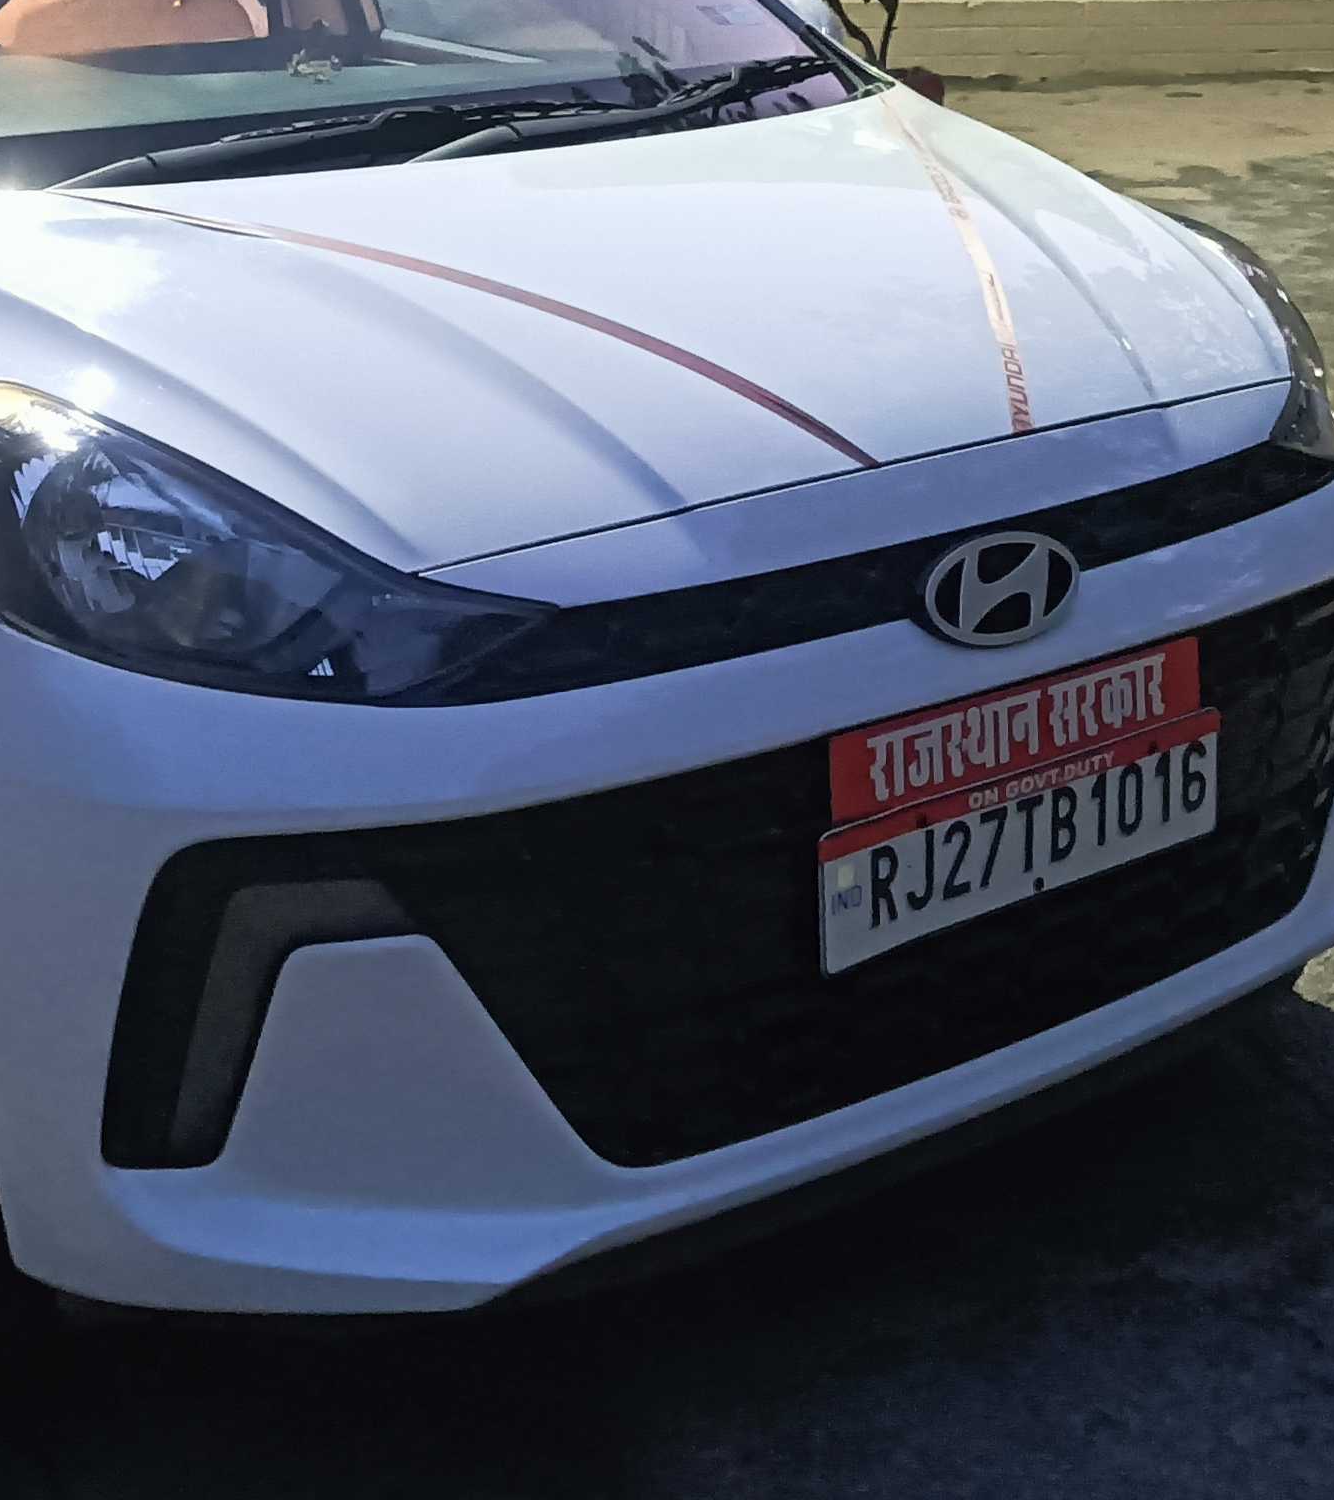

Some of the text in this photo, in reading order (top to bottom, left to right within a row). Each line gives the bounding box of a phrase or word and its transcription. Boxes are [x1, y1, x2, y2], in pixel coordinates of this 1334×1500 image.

[867, 653, 1166, 801] राजस्थान सरकार
[968, 787, 998, 810] ON
[868, 740, 1208, 930] RJ27TB1016
